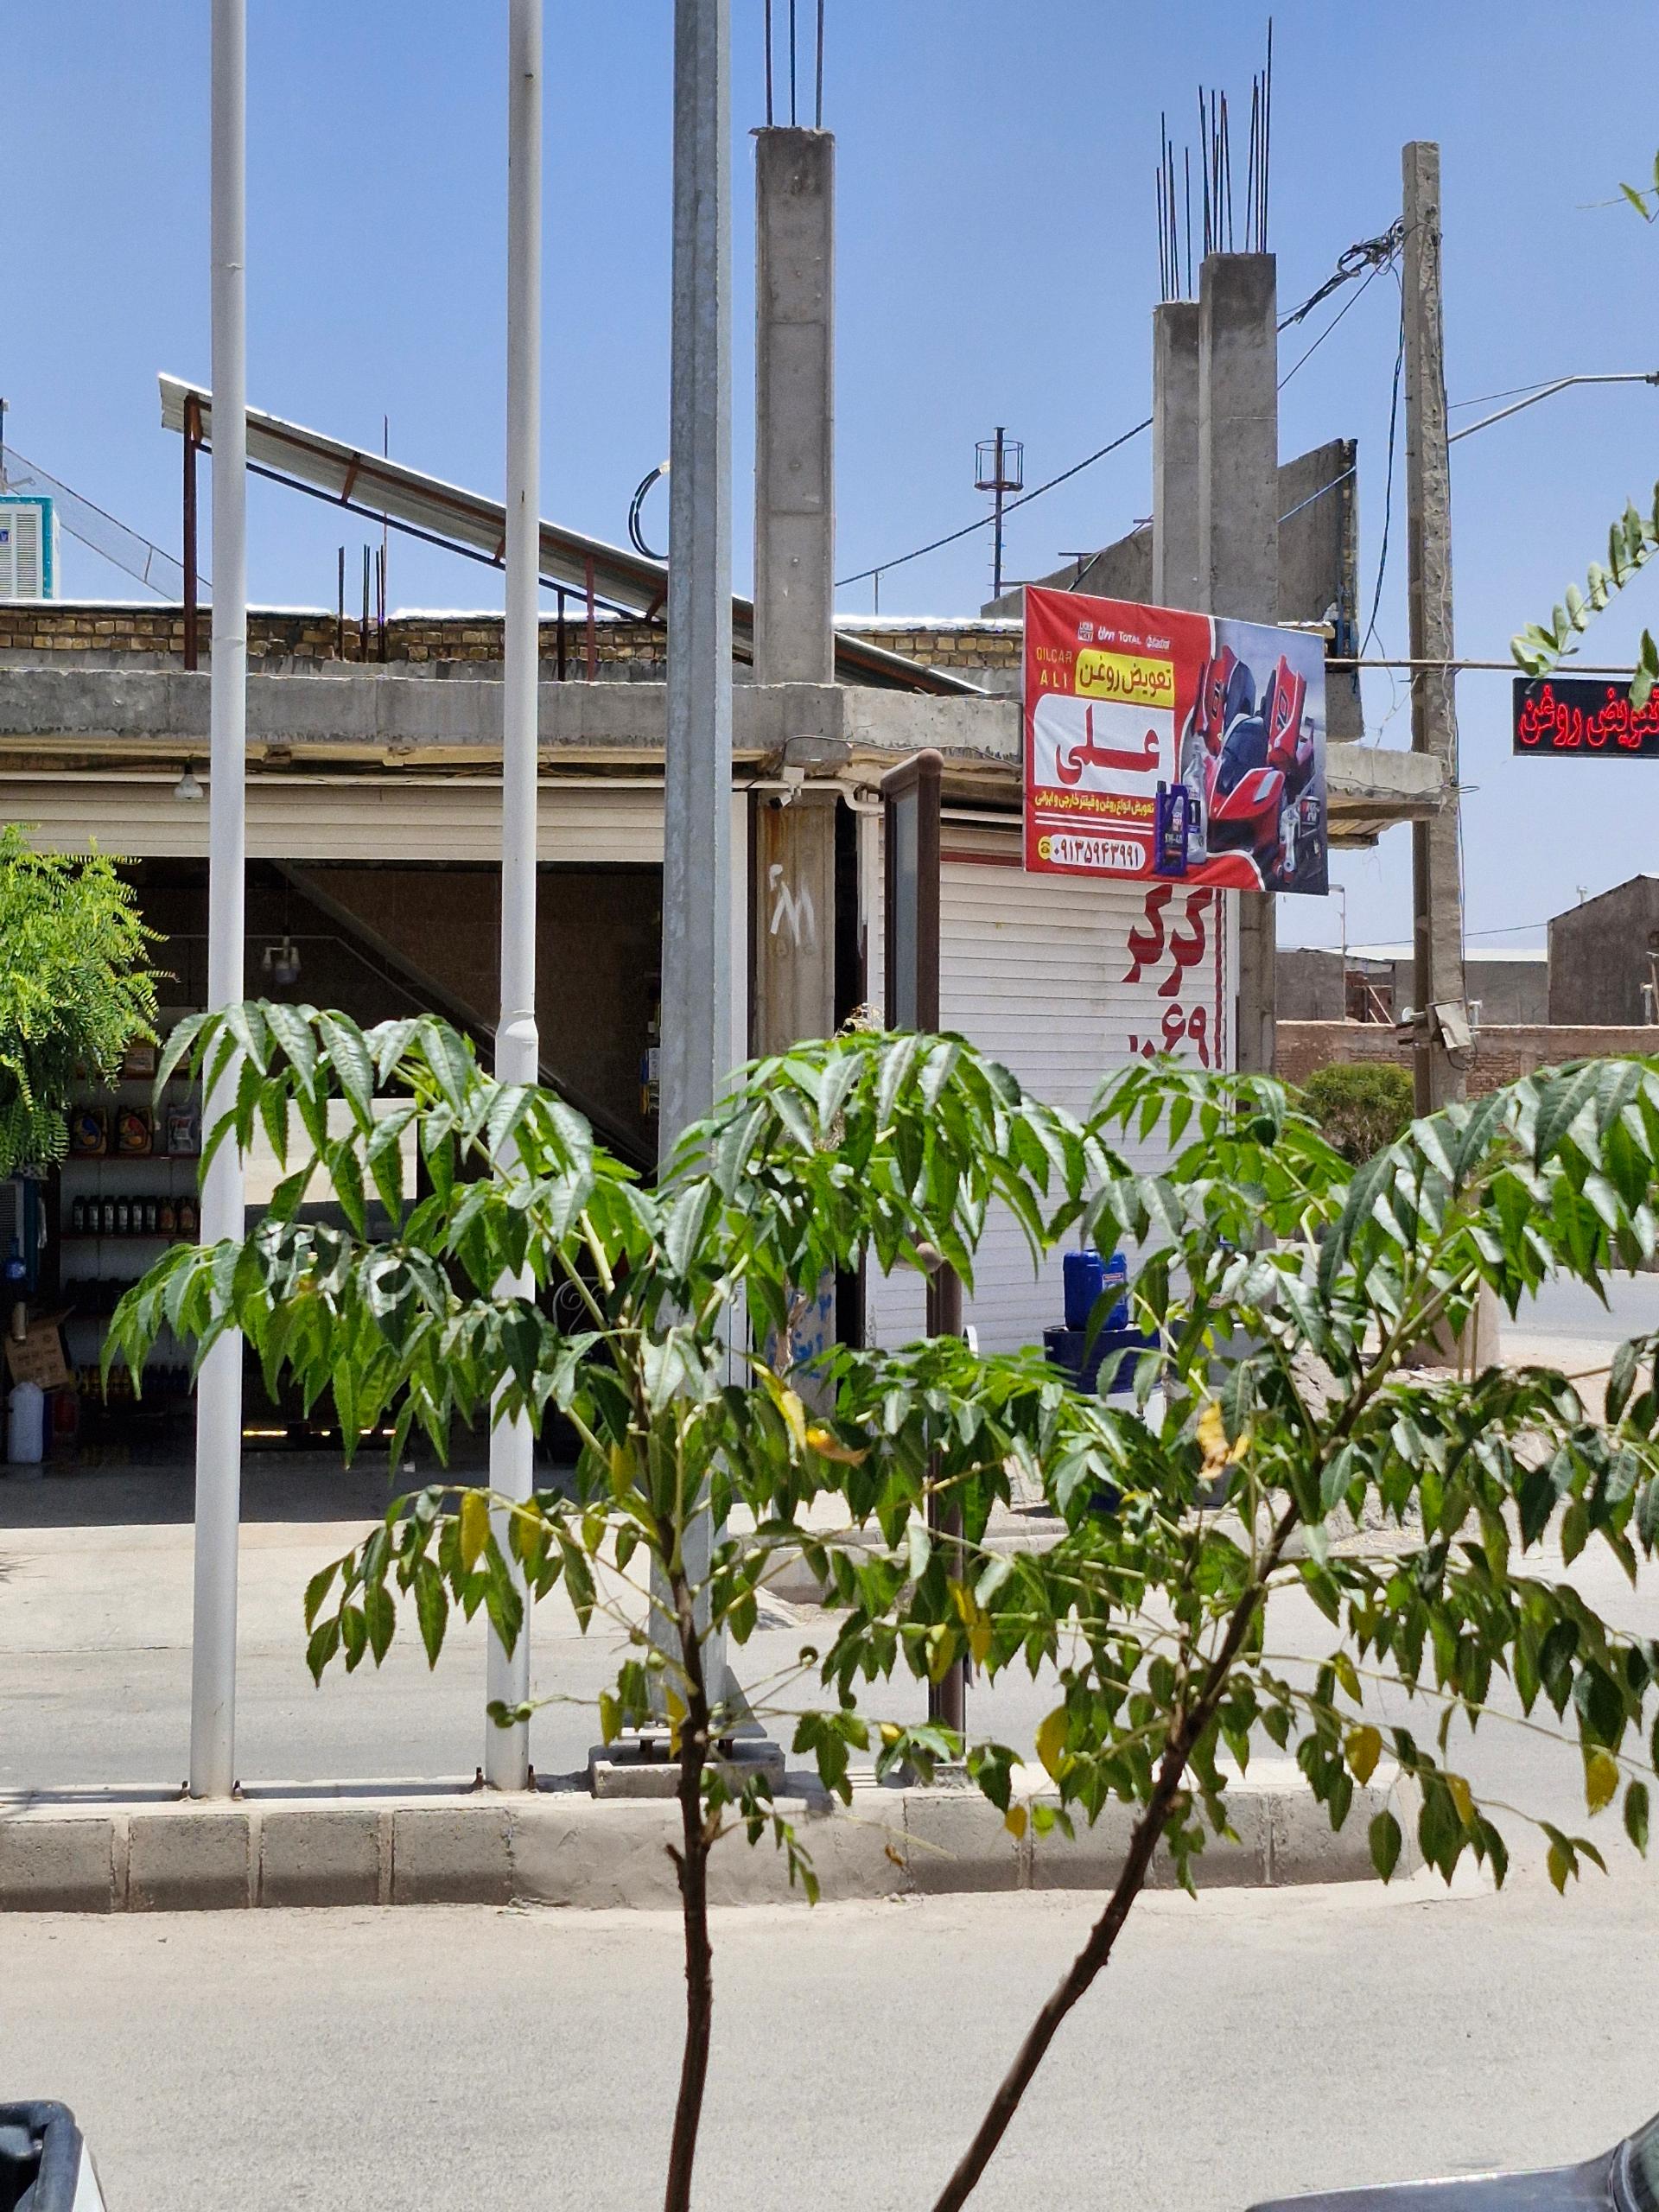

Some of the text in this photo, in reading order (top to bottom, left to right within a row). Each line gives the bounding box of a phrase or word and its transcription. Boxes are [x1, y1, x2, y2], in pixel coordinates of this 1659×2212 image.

[1037, 646, 1071, 664] OILCAR
[1039, 669, 1068, 689] ALI
[1080, 654, 1172, 697] تعویض روغن
[1520, 683, 1582, 747] روغن
[1056, 703, 1160, 785] علی
[1132, 799, 1154, 817] تعویض
[1054, 838, 1139, 868] ۰۹۱۳۵۹۴۳۹۹۱
